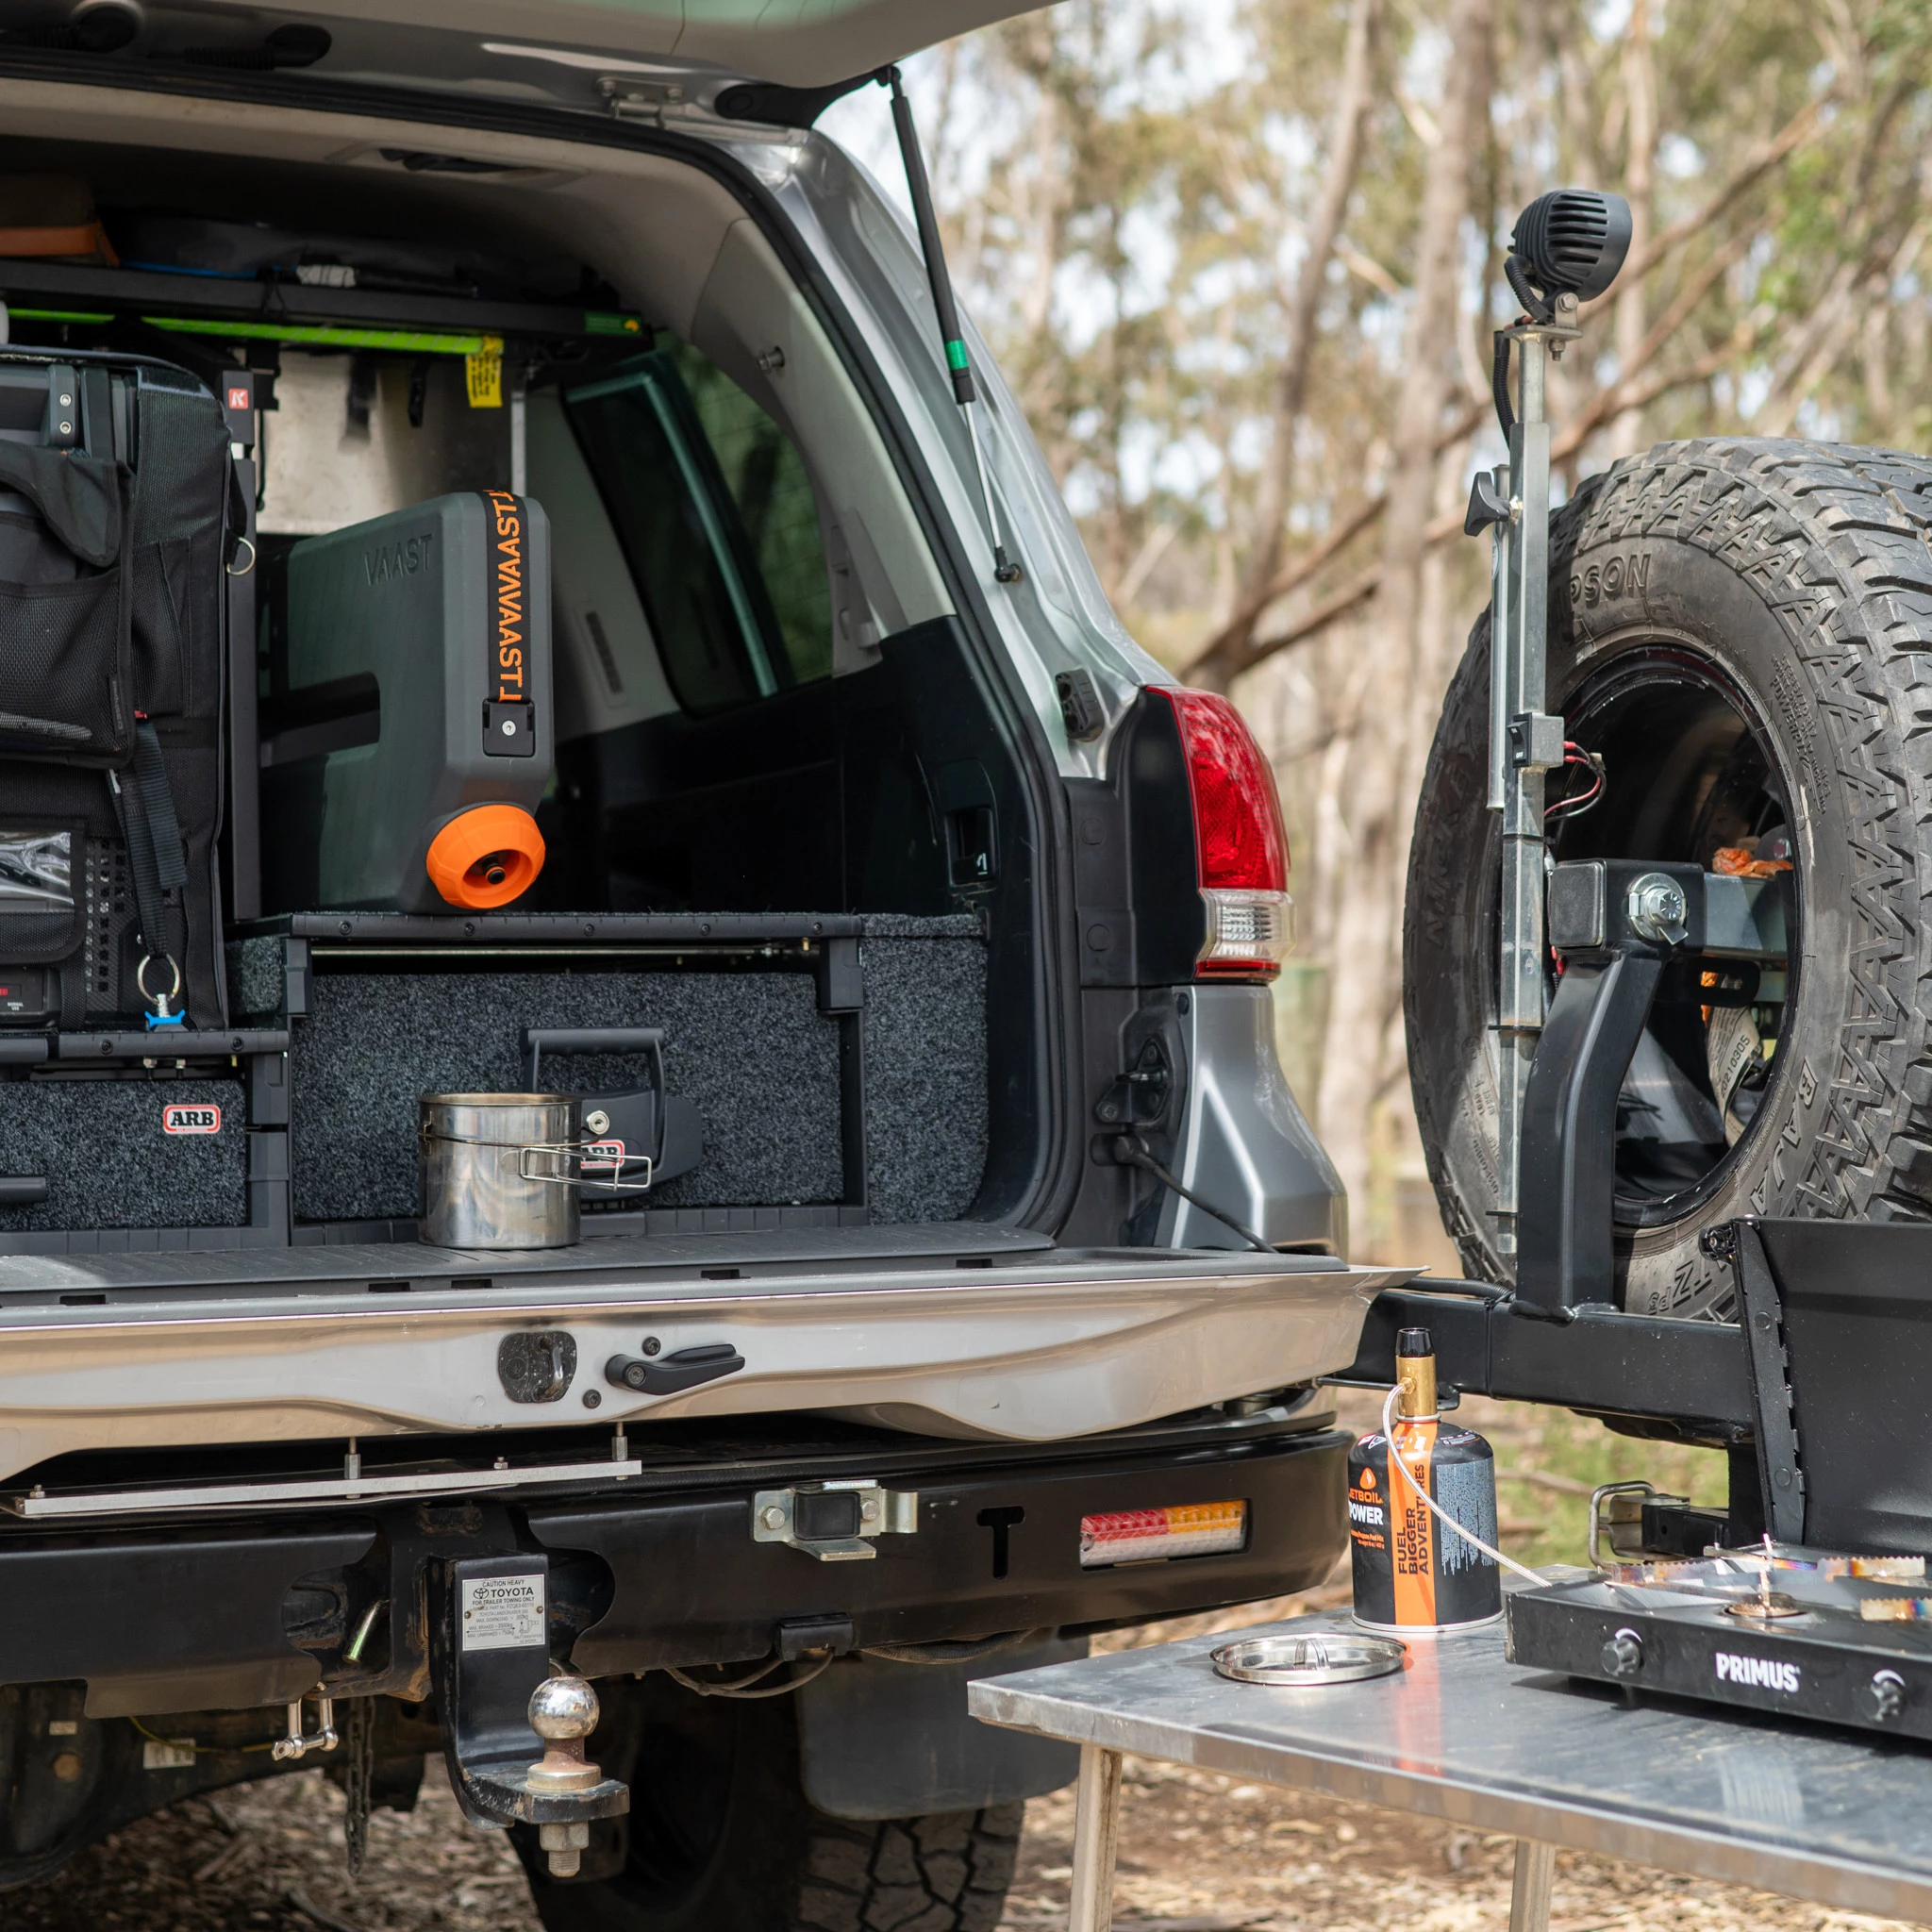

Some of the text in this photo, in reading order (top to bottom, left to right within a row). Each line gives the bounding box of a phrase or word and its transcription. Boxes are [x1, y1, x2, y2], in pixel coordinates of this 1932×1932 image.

[364, 533, 432, 586] VAAST
[1569, 553, 1652, 604] PSON
[499, 591, 523, 688] VAAST
[171, 1111, 214, 1125] ARB
[1750, 1056, 1819, 1216] BAJA
[1349, 1488, 1383, 1504] ETBOIL
[1415, 1464, 1429, 1575] ADVENTRES
[1397, 1526, 1407, 1574] FUEL
[1407, 1507, 1418, 1575] BIGGER
[491, 1587, 534, 1598] TOYOTA
[1715, 1652, 1799, 1693] PRIMUS
